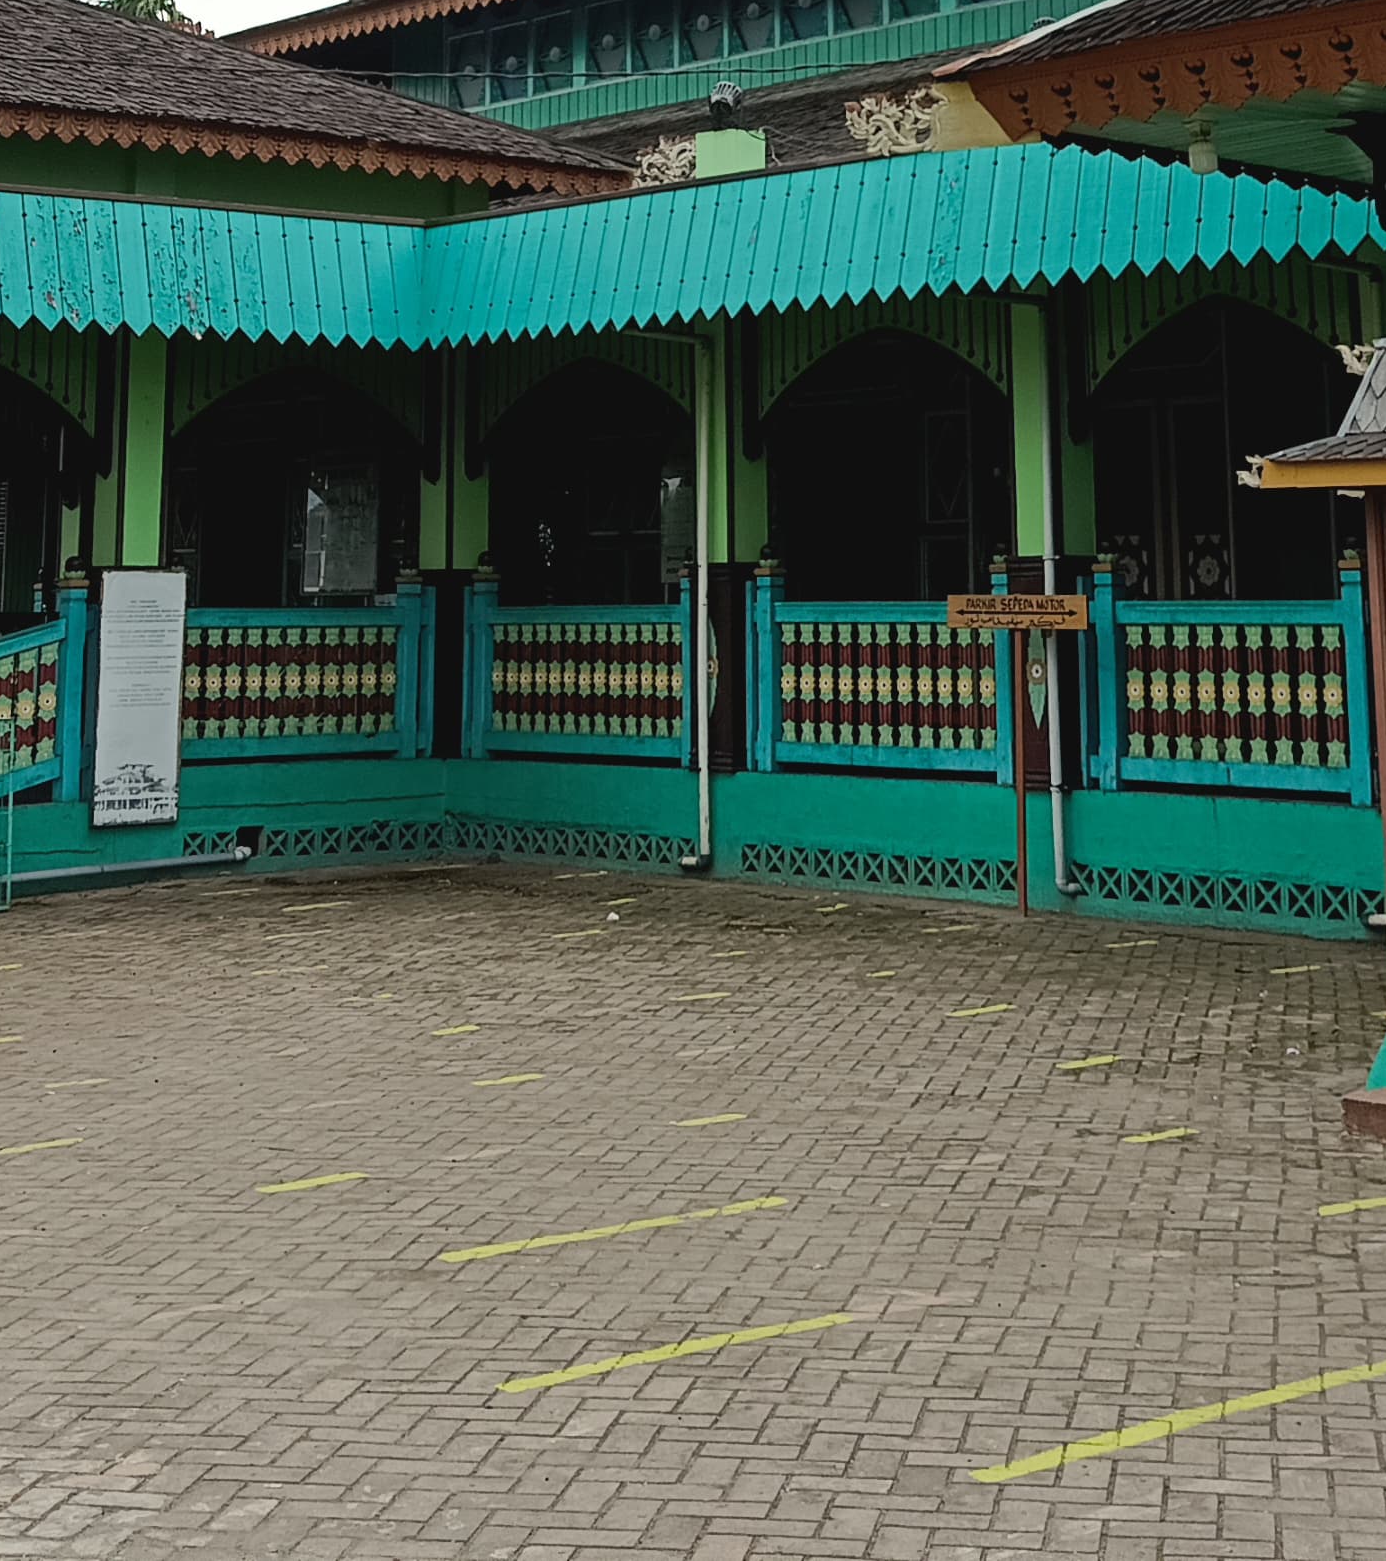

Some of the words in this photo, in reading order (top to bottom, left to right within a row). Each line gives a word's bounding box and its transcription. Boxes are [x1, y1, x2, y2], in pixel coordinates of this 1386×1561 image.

[966, 598, 997, 610] PARKIR
[1001, 596, 1034, 611] SEPEDA
[1036, 598, 1066, 611] MOTOR
